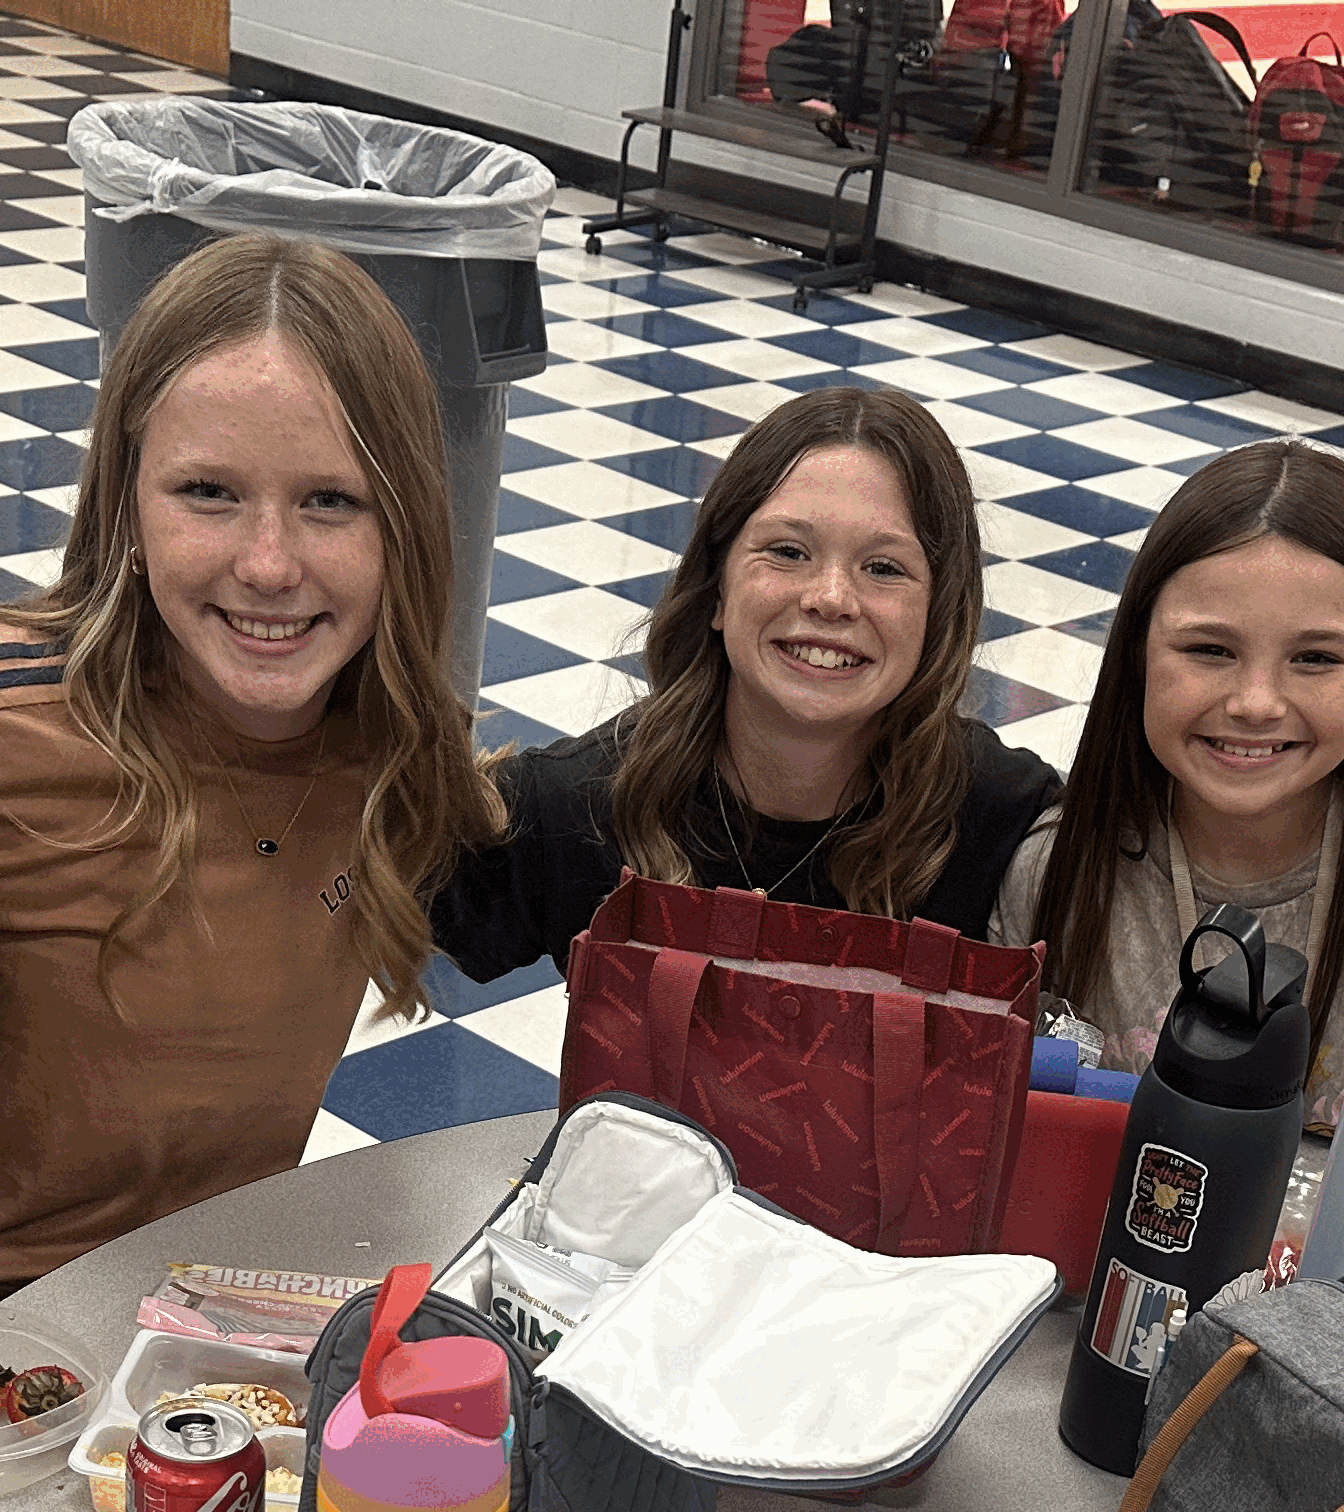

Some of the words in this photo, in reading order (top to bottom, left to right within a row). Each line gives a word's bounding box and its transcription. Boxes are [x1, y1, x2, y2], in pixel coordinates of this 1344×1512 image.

[600, 985, 642, 1027] lululemon
[742, 1003, 785, 1044] lululemon
[799, 1021, 836, 1067] lululemon
[720, 1051, 765, 1085] lululemon
[692, 1075, 717, 1127] lululemon
[759, 1080, 807, 1102] lululemon
[737, 1121, 783, 1158] lululemon
[822, 1100, 859, 1144] lululemon
[930, 1108, 972, 1146] lululemon
[803, 1121, 822, 1173] lululemon
[1170, 1157, 1186, 1168] LET
[1185, 1164, 1205, 1177] THE
[796, 1186, 841, 1220] lululemon
[1165, 1210, 1172, 1219] A
[1180, 1195, 1196, 1208] YOU
[1133, 1201, 1191, 1240] Softball
[1141, 1227, 1174, 1246] BEAST
[517, 1290, 551, 1314] ARTIFICIAL
